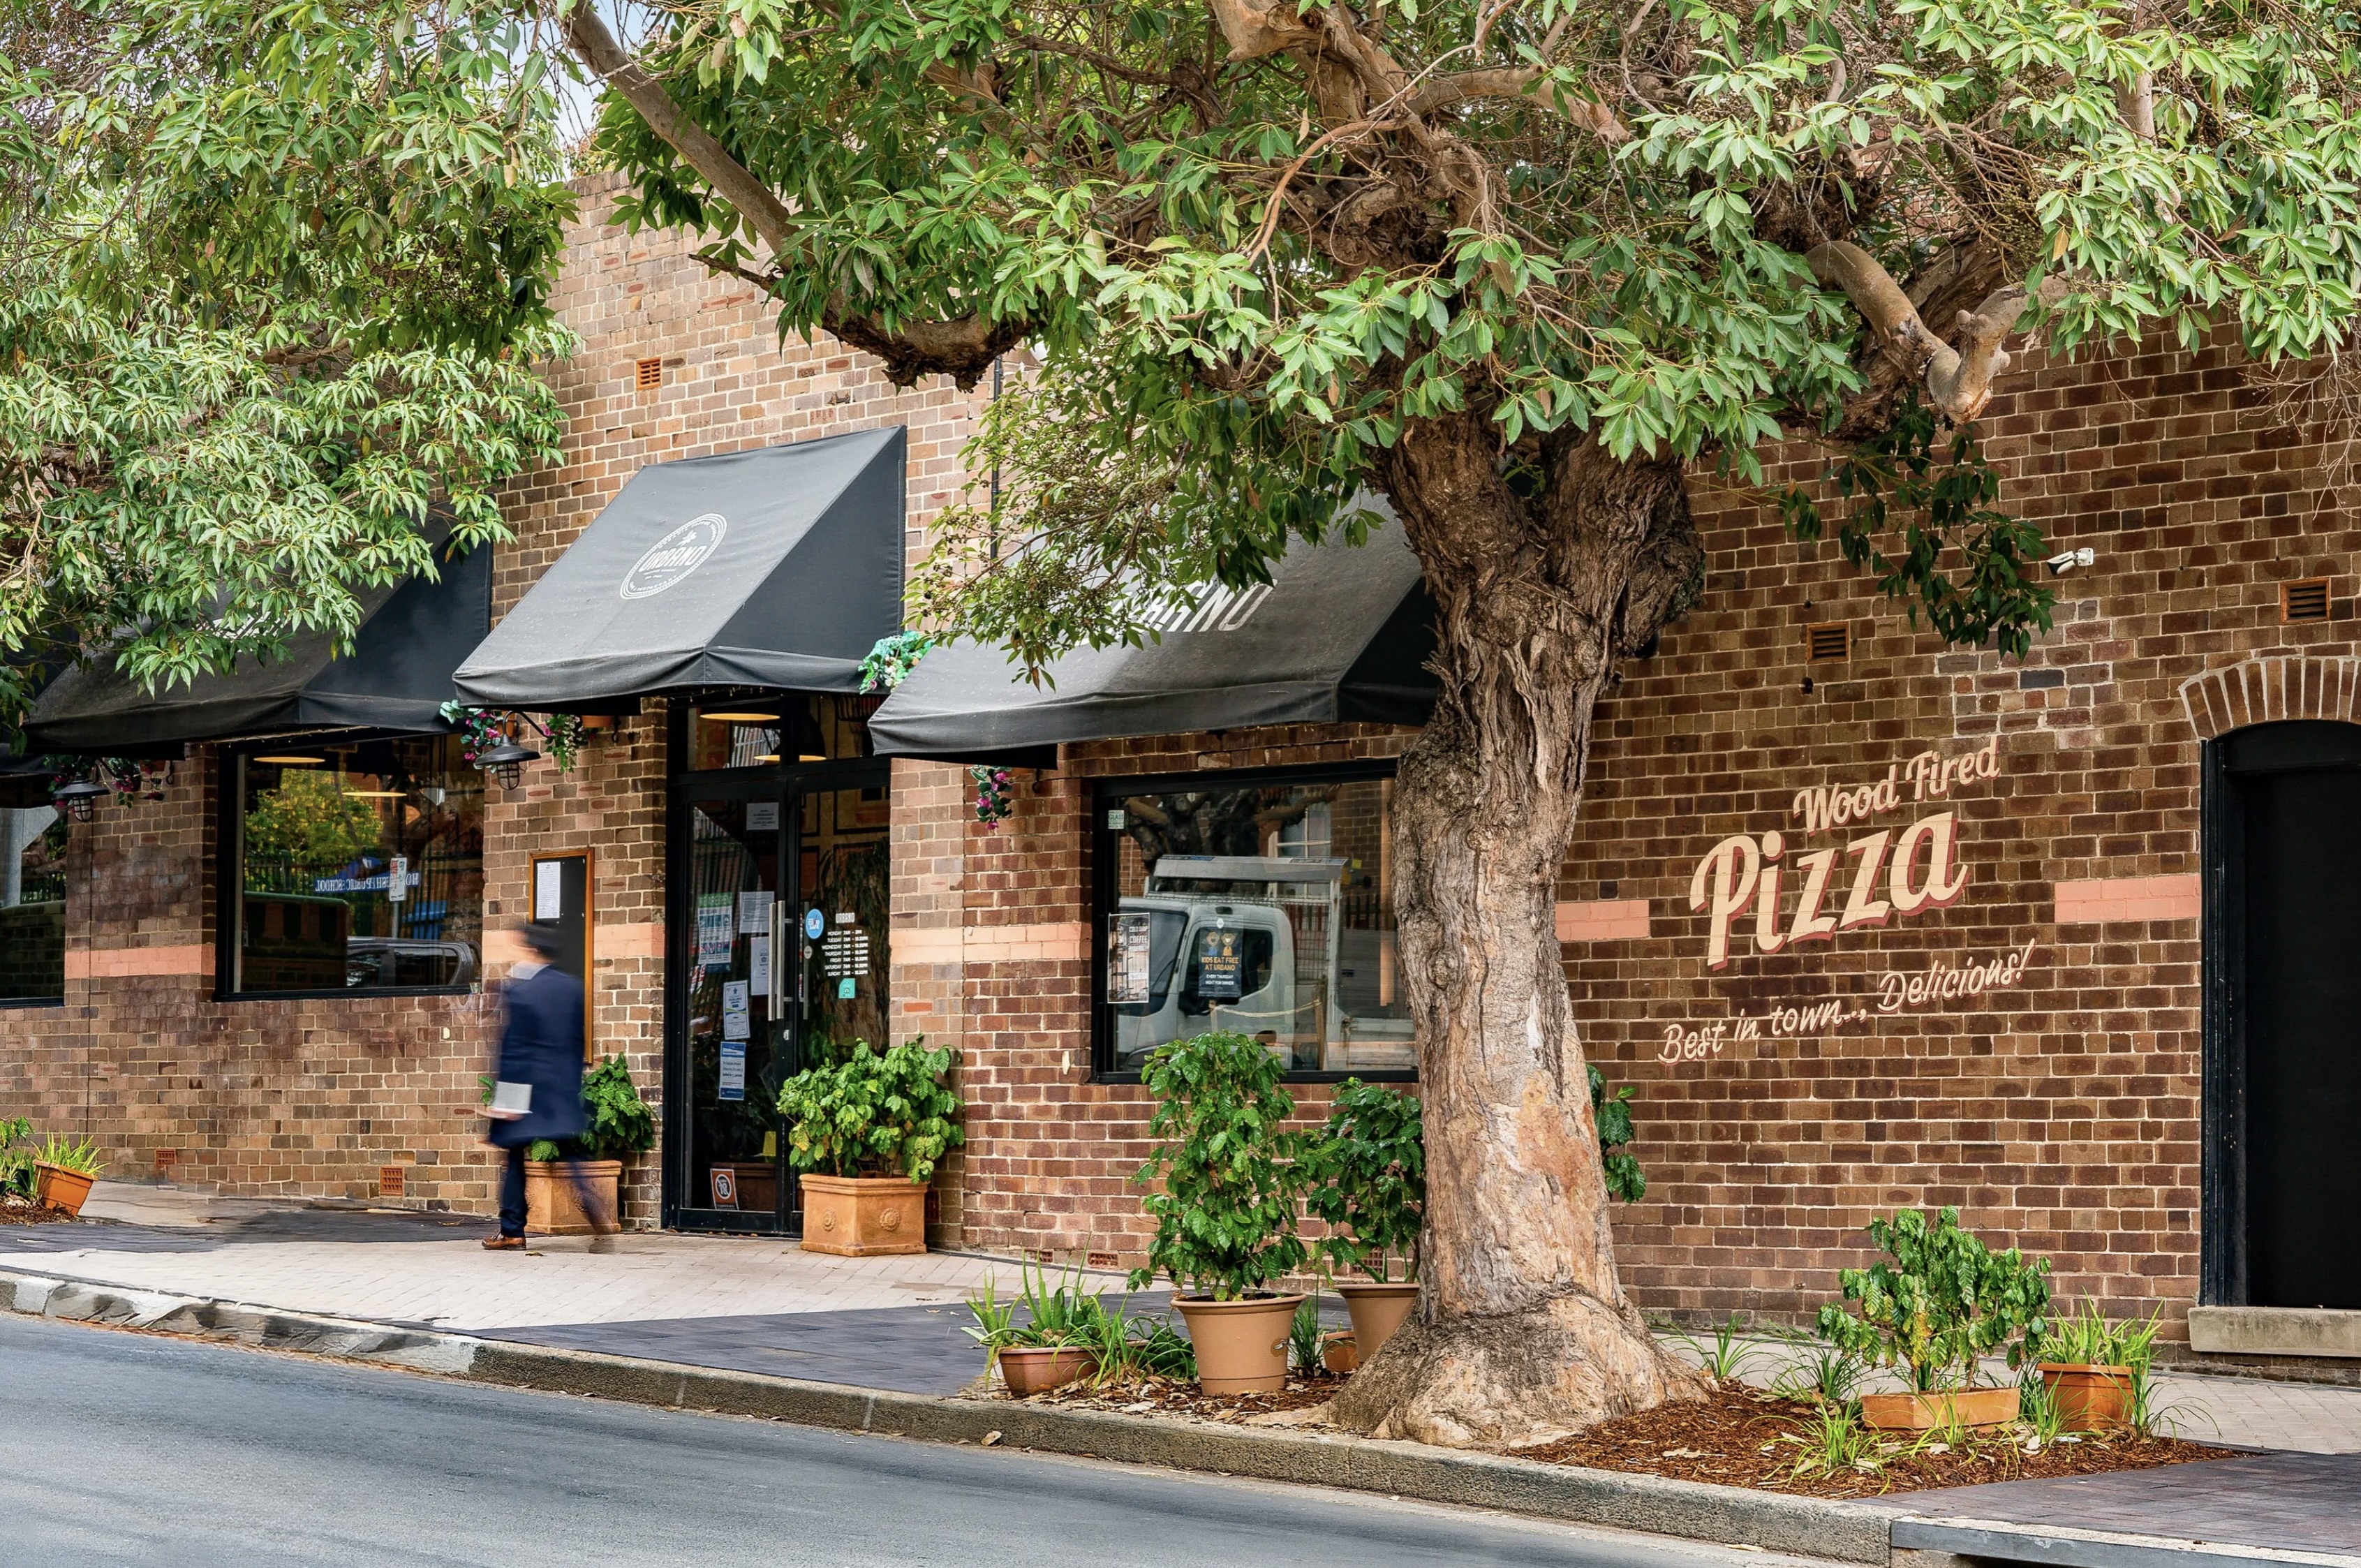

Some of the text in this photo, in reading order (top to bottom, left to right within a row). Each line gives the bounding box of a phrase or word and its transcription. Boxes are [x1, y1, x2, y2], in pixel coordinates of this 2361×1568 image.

[638, 546, 707, 572] URBANO
[1793, 736, 2001, 836] Wood Fired
[1130, 935, 1148, 943] COFFEE
[1689, 811, 1970, 971] Pizza
[1657, 1020, 1726, 1066] Best
[1734, 1008, 1761, 1043] in
[1877, 938, 2036, 1013] Delicious!
